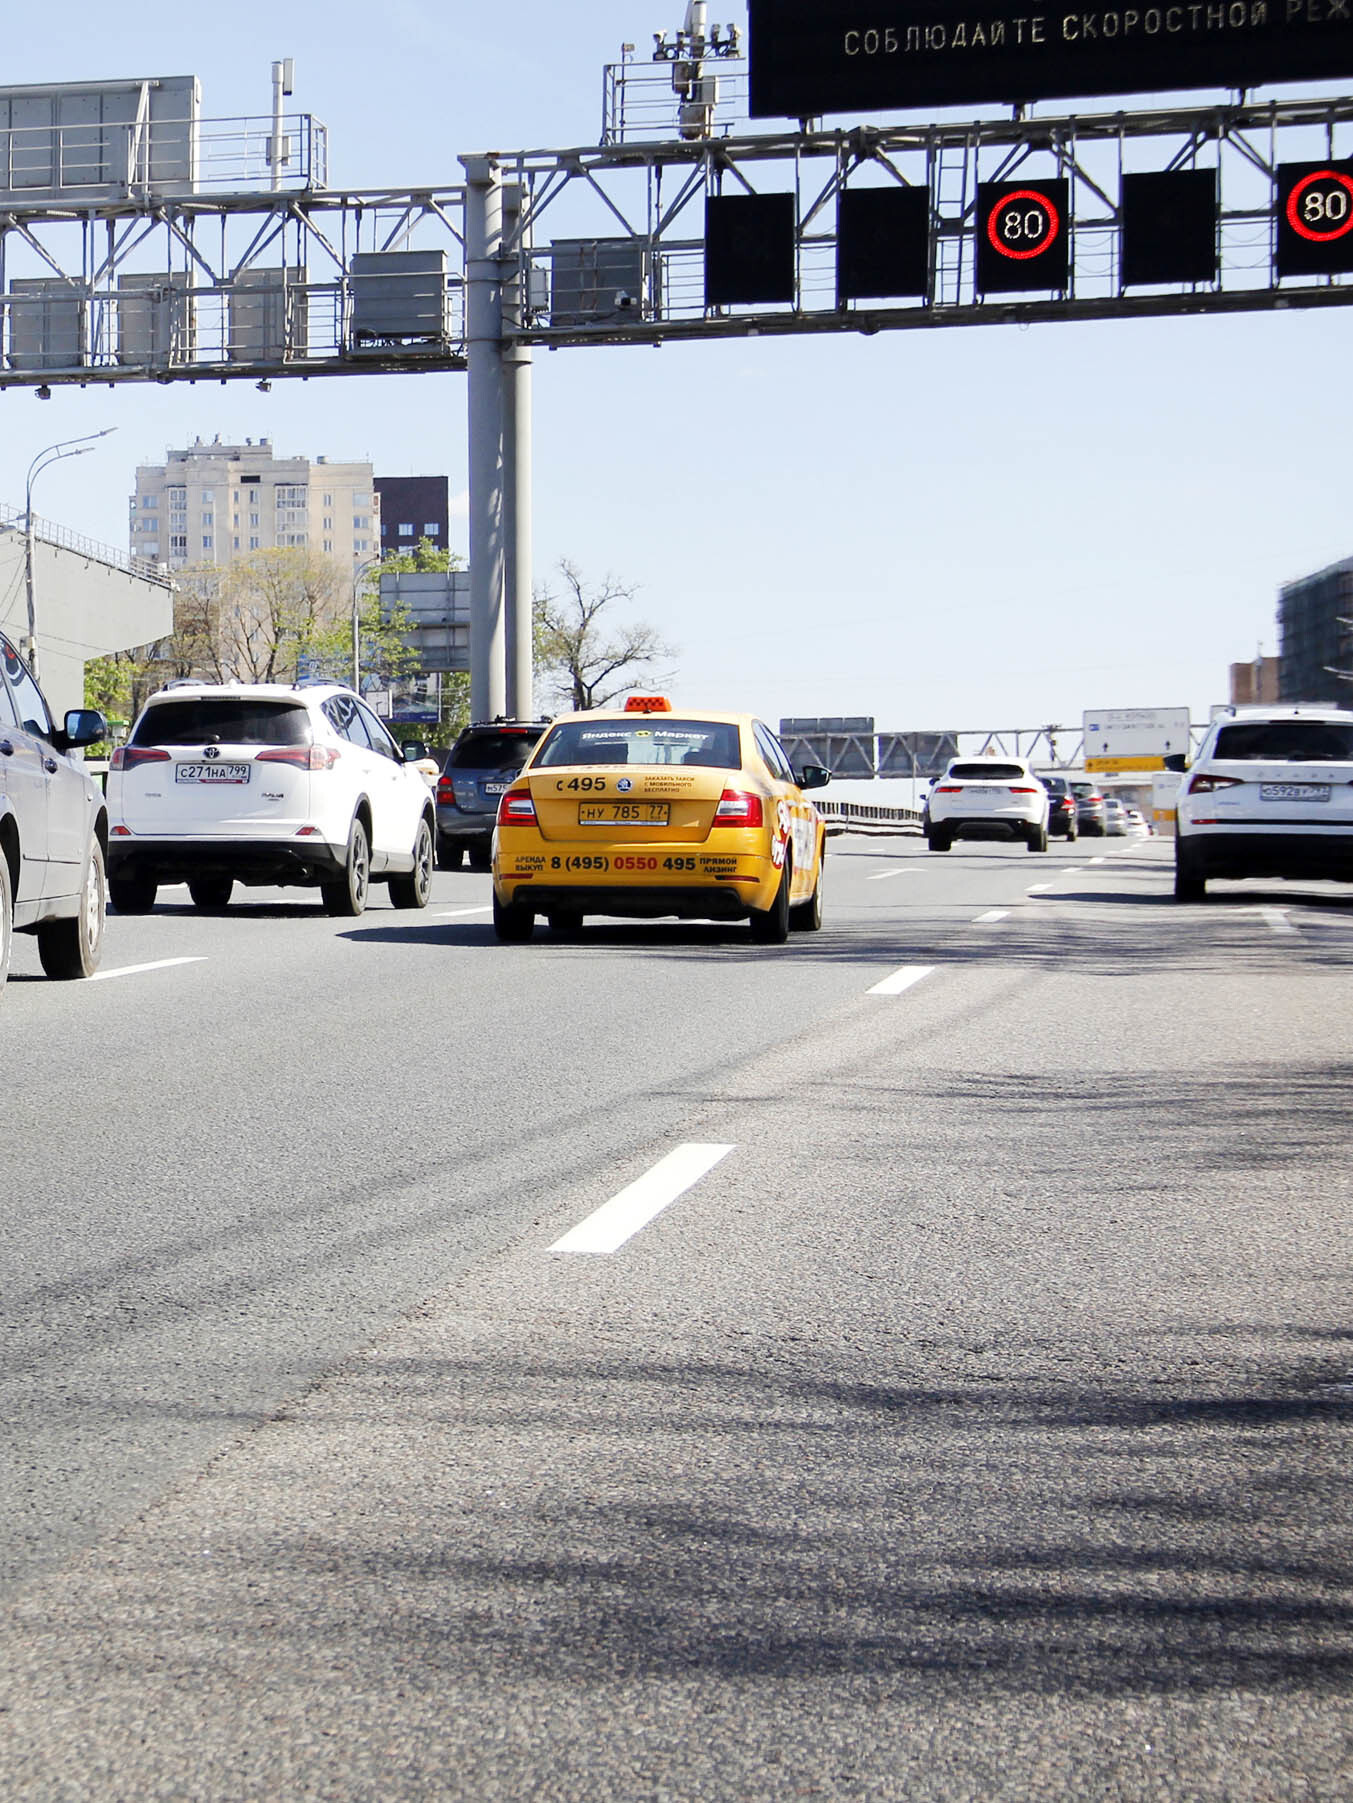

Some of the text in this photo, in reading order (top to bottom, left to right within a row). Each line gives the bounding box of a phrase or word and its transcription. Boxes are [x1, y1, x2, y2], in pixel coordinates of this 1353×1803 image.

[844, 17, 1047, 56] СОБЛЮДАЙТЕ
[1062, 1, 1267, 41] СКОРОСТНОЙ
[1304, 190, 1347, 222] 80
[1003, 209, 1043, 240] 80
[581, 730, 710, 740] Яндекс Маркет
[229, 765, 247, 775] 799
[567, 777, 606, 792] 495
[612, 805, 640, 819] 785
[649, 805, 663, 816] 77
[515, 864, 544, 872] ВЫКУП
[550, 856, 696, 872] 8 (495) 0550 495
[699, 857, 738, 865] ПРЯМОЙ
